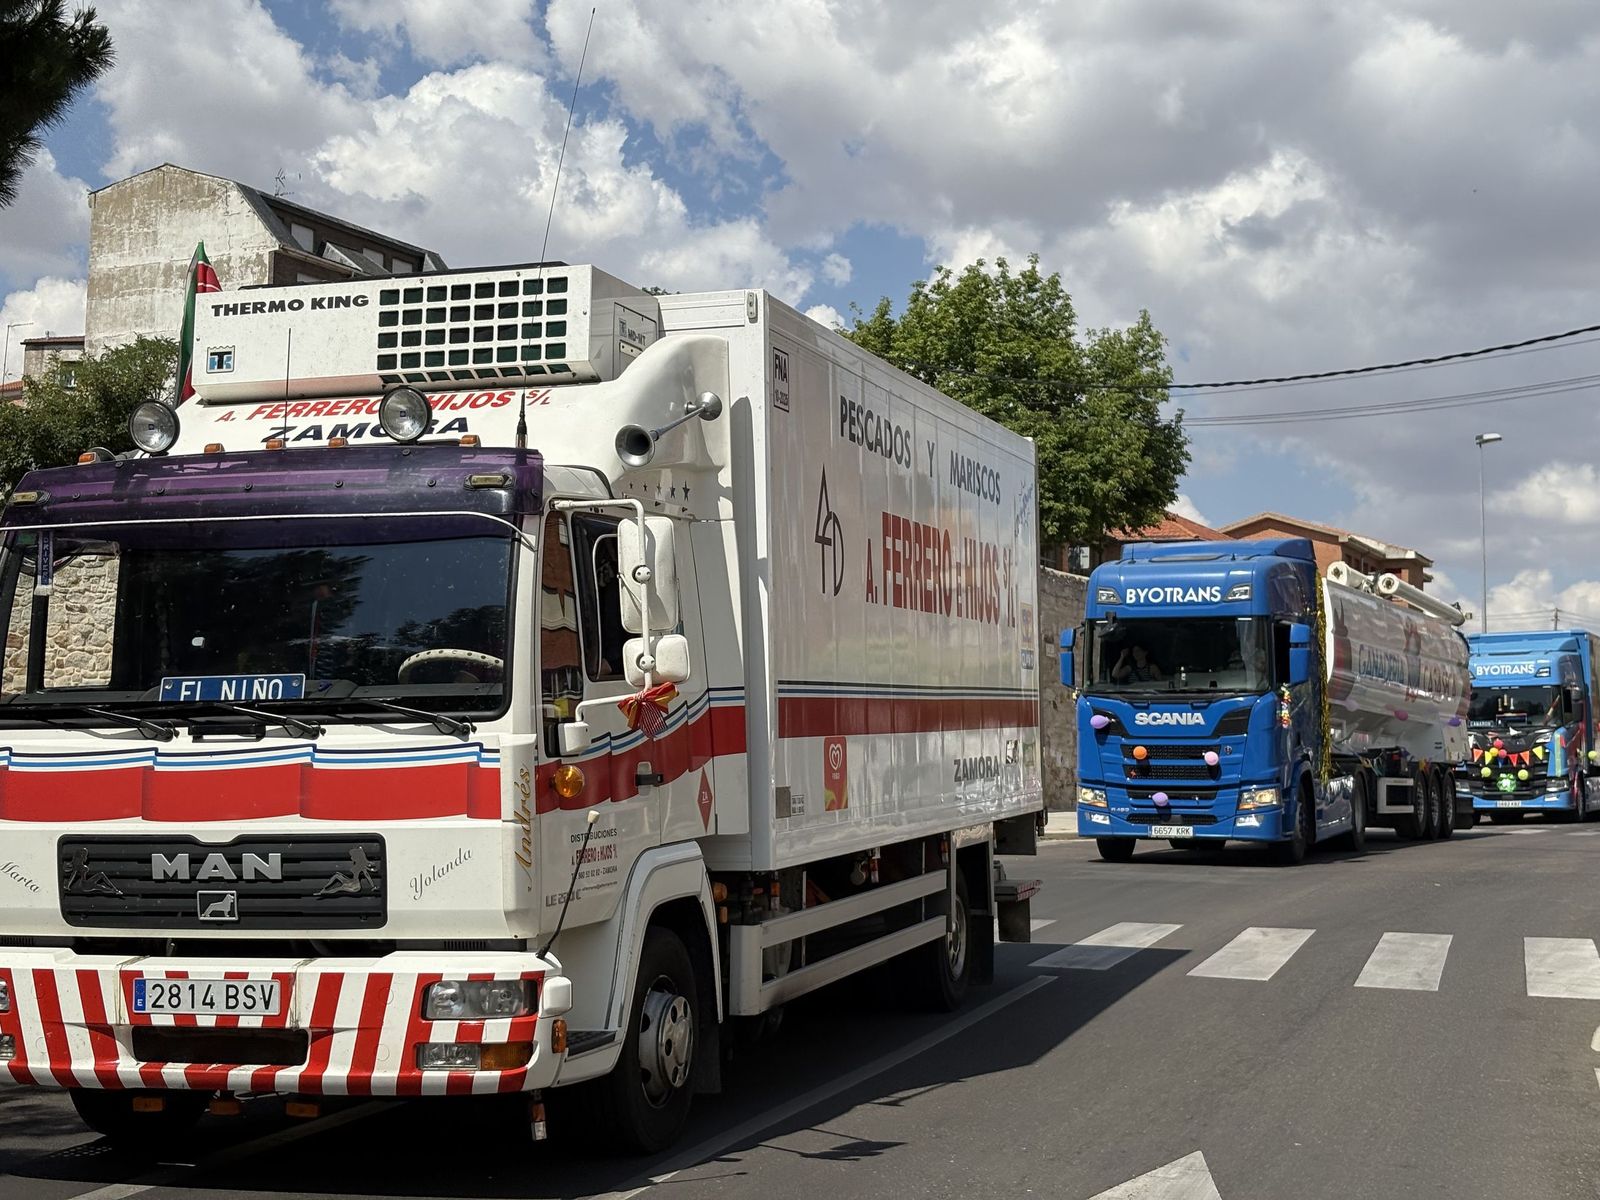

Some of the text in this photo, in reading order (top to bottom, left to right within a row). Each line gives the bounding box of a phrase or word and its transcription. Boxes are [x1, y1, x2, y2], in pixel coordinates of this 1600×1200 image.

[211, 294, 369, 317] THERMO KING
[214, 409, 236, 423] A.
[839, 394, 1001, 506] PESCADOS Y MARISCOS
[866, 537, 878, 605] A.
[881, 511, 951, 618] FERRERO
[964, 536, 1000, 625] HIJOS
[1126, 586, 1221, 604] BYOTRANS
[1476, 664, 1535, 676] BYOTRANS
[220, 678, 283, 701] NIÑO
[1134, 712, 1206, 726] SCANIA
[953, 755, 1000, 783] ZAMORA
[513, 763, 532, 892] Andrés
[1153, 826, 1190, 835] 6657 KRK
[151, 853, 282, 880] MAN
[409, 847, 472, 901] Yolanda
[151, 983, 274, 1010] 2814 BSV
